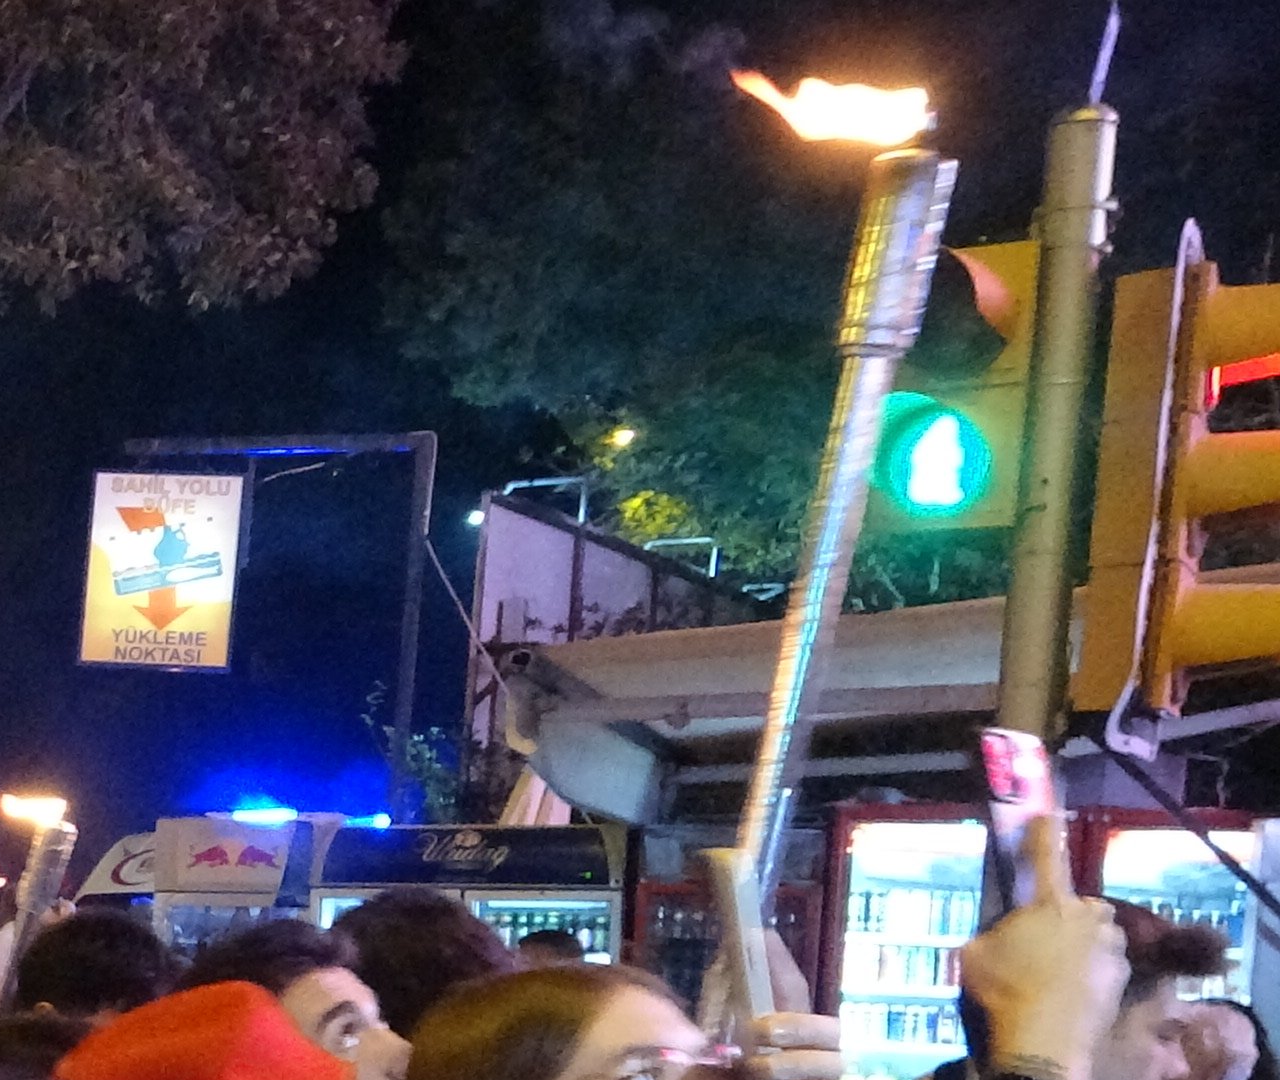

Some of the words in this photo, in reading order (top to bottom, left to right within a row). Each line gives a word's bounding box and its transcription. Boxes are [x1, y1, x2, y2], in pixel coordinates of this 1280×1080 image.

[176, 478, 231, 496] YOLU
[112, 626, 208, 647] YÜKLEME
[113, 646, 202, 664] NOKTASI
